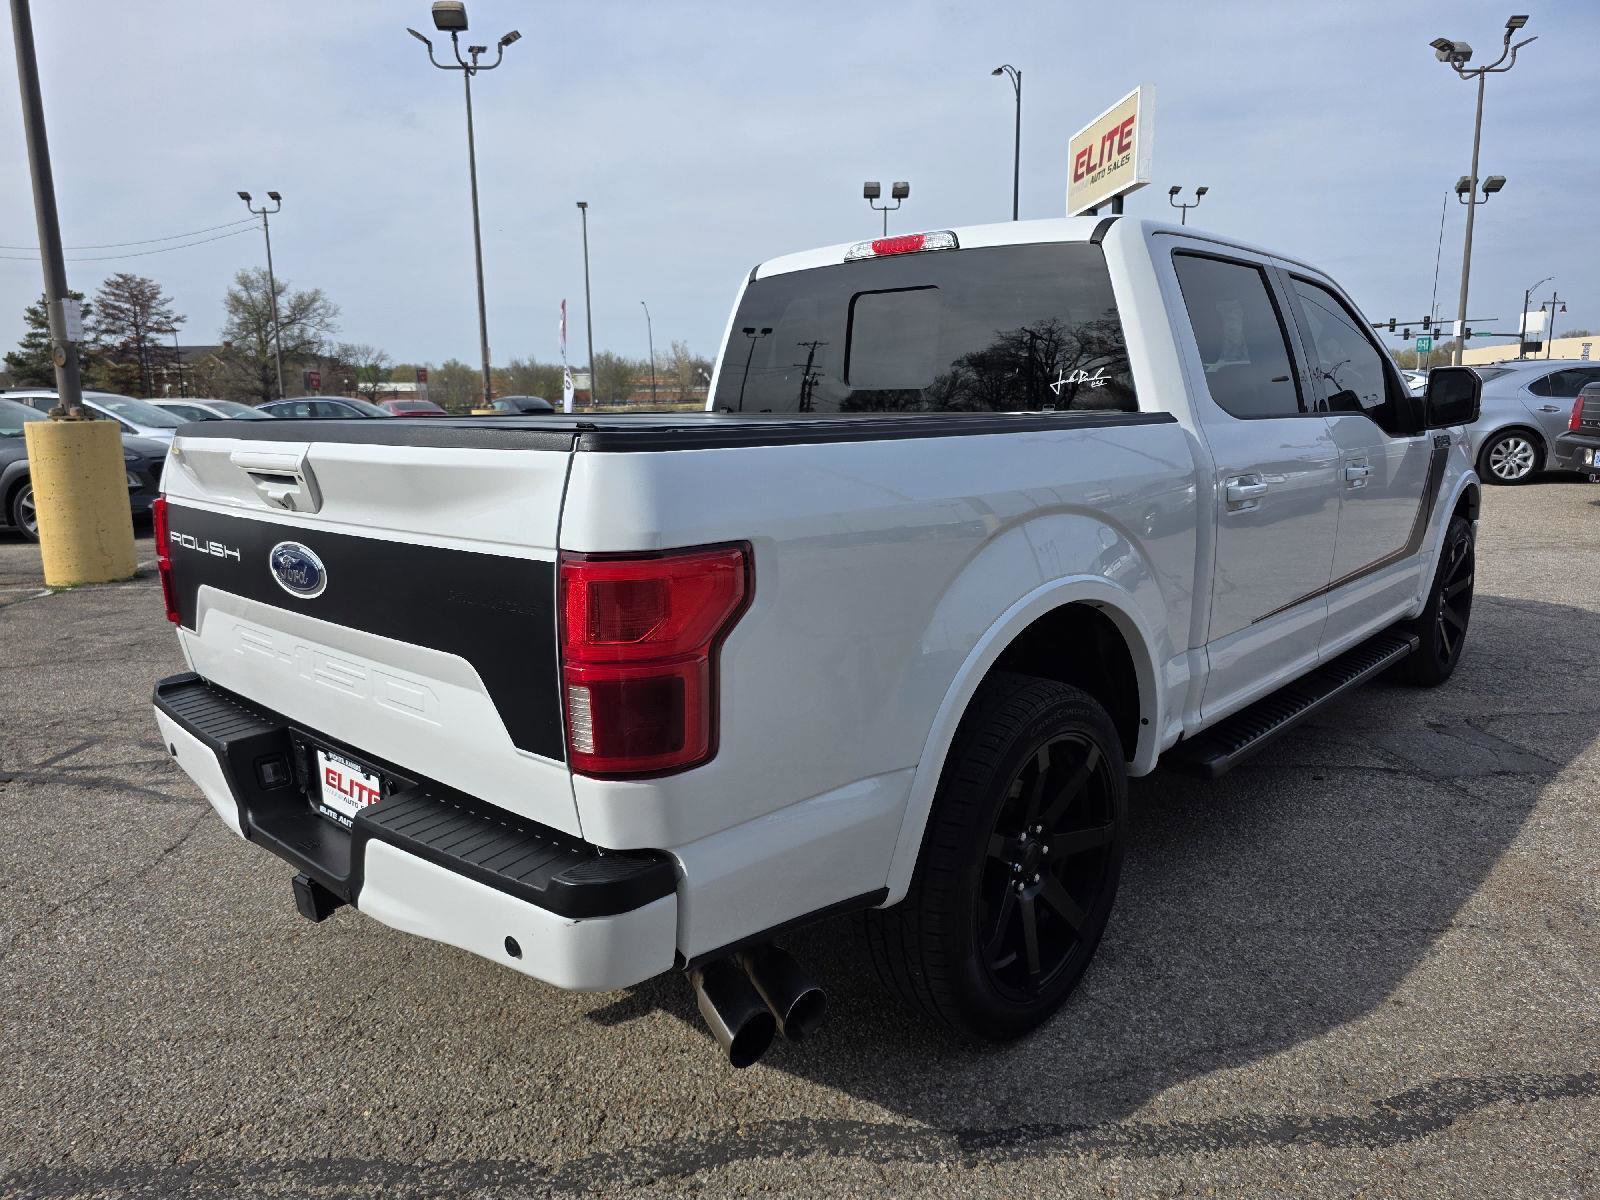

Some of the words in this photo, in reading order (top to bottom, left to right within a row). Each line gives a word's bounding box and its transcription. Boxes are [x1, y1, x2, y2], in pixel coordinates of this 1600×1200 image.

[1073, 114, 1136, 184] ELITE
[1090, 168, 1106, 186] AUTO
[1106, 153, 1131, 176] SALES
[170, 531, 241, 561] ROUSH
[279, 554, 309, 585] Ford
[325, 767, 381, 807] ELITE
[319, 805, 338, 820] ELITE
[338, 815, 354, 828] AUT
